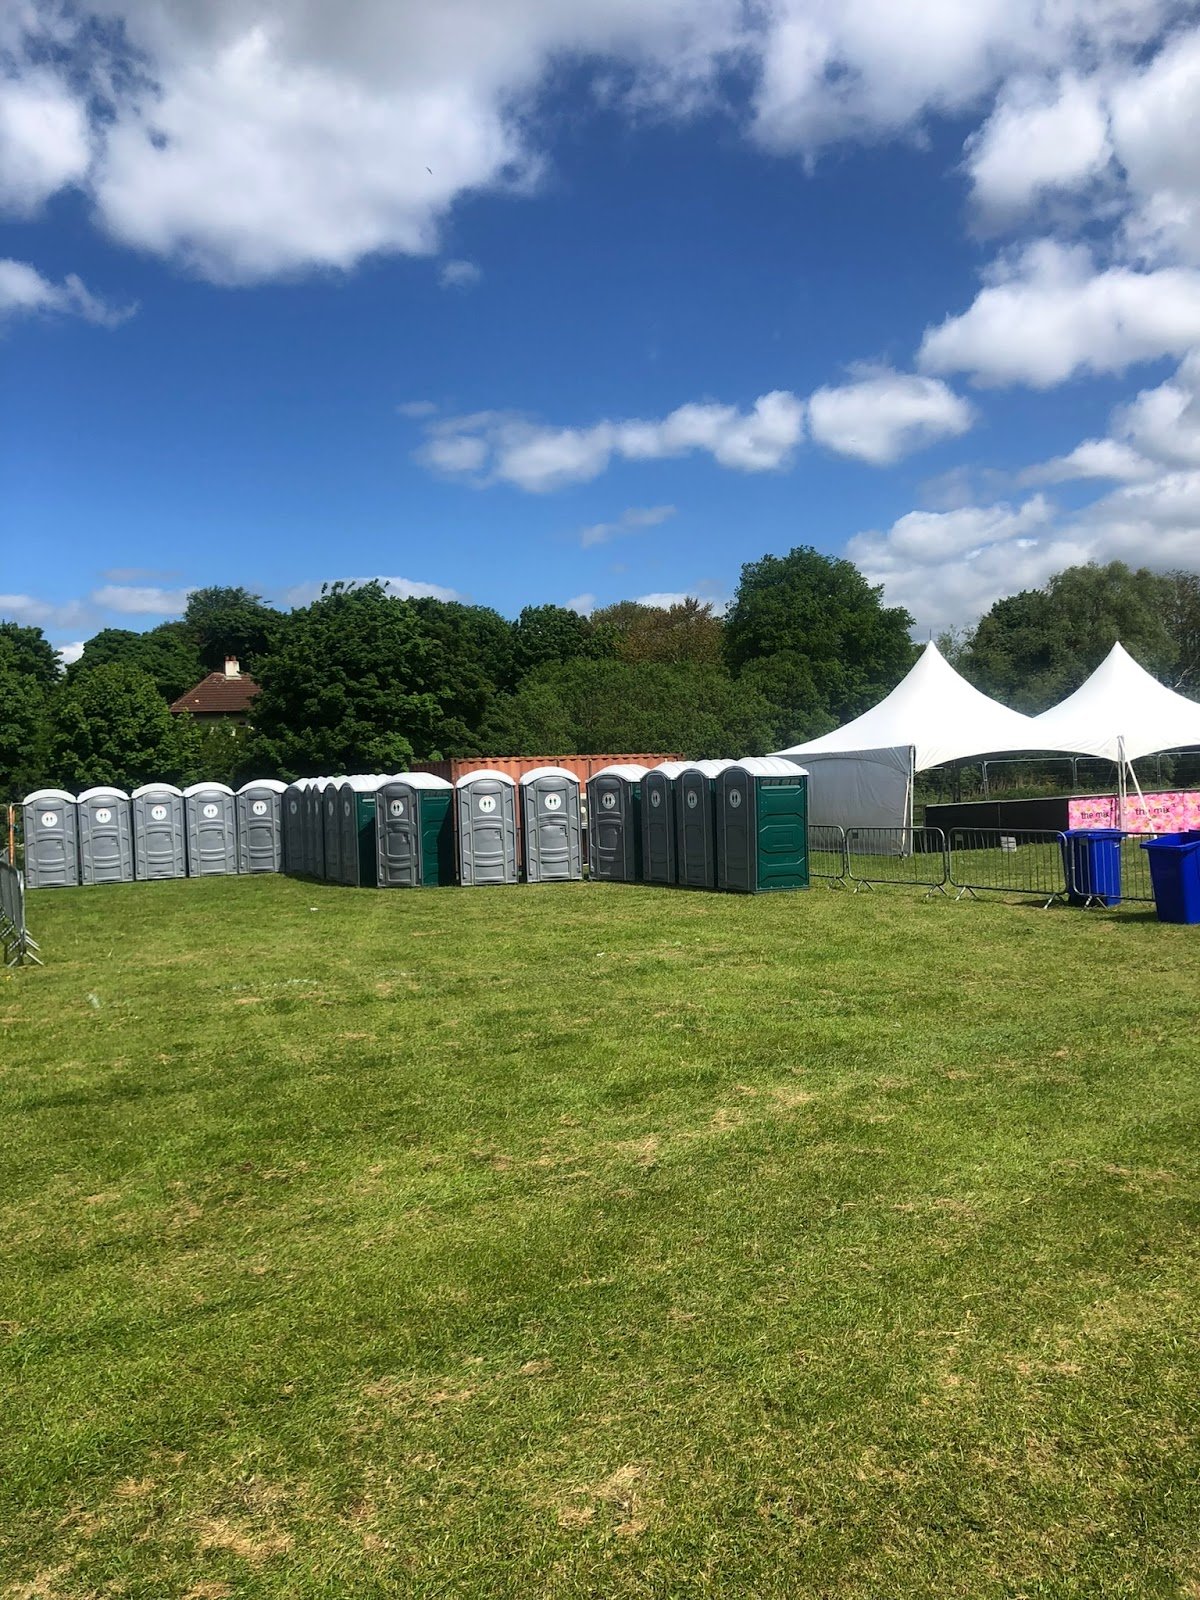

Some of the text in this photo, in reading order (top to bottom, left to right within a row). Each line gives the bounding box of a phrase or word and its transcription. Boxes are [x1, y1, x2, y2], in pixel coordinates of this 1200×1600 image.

[1080, 811, 1094, 820] the
[1135, 806, 1170, 816] th mix
